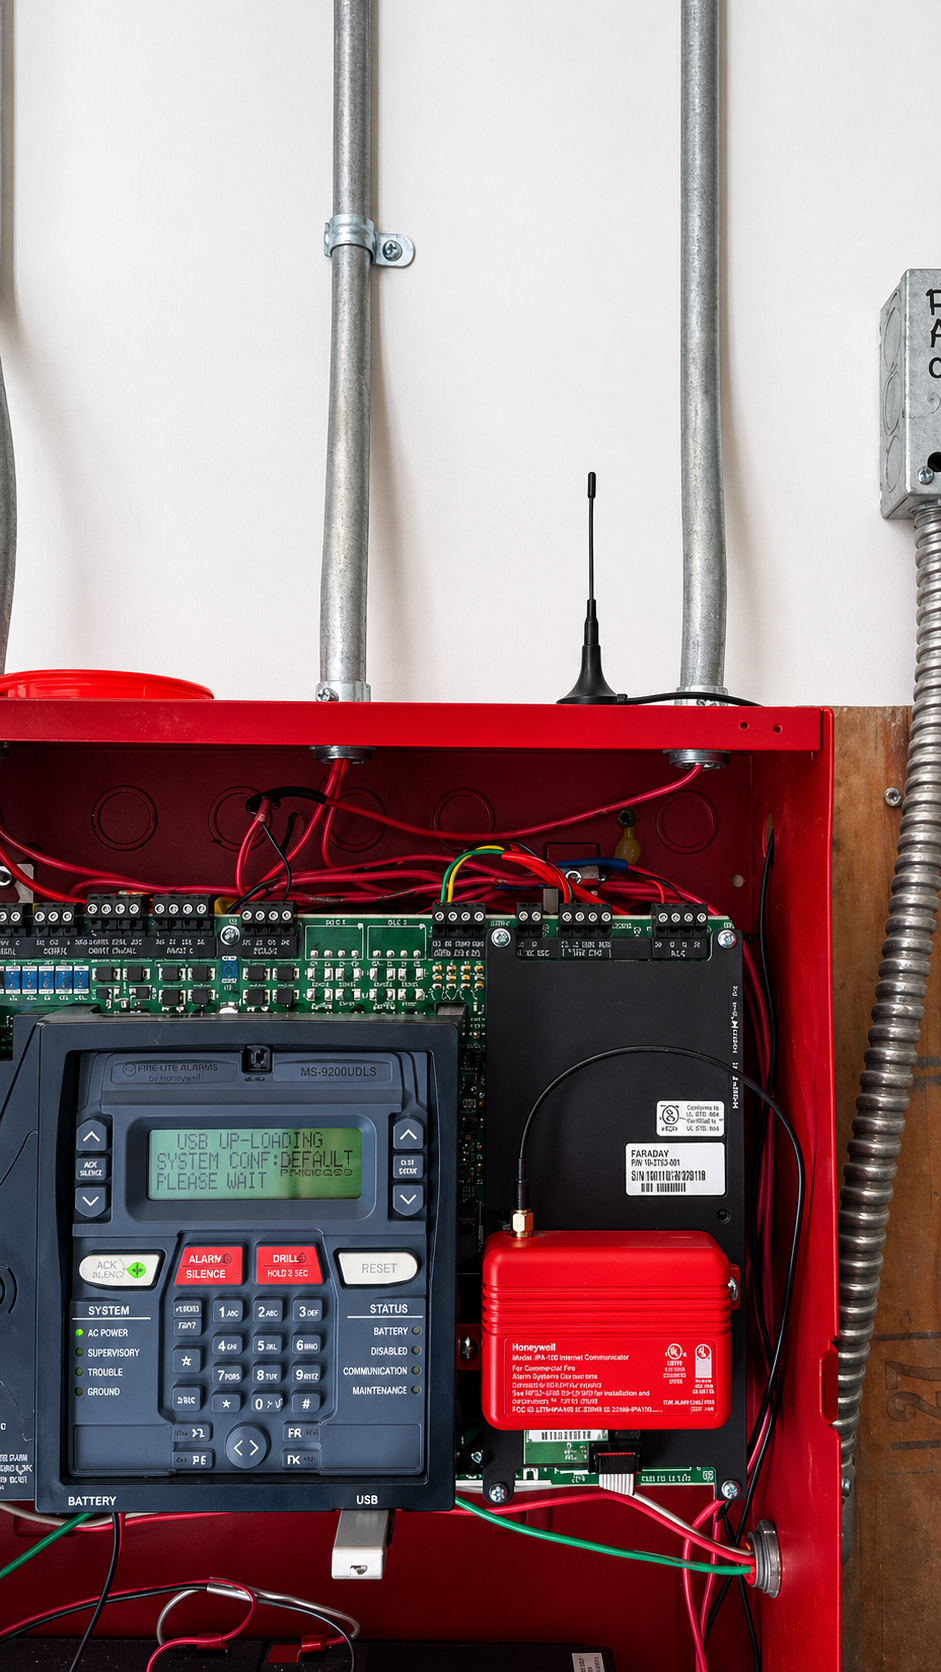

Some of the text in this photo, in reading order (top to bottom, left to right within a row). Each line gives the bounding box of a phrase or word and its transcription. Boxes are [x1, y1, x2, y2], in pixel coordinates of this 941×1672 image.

[180, 1063, 218, 1071] ALARMS
[300, 1066, 377, 1077] MS-9200UDLS
[177, 1131, 323, 1150] USB UP-LOADING
[631, 1149, 669, 1158] FARADAY
[157, 1149, 353, 1170] SYSTEM CONF:DEFAULT
[157, 1172, 218, 1190] PLEASE
[226, 1171, 267, 1190] WAIT
[272, 1254, 300, 1263] DRILL
[95, 1260, 118, 1270] ACK
[361, 1263, 398, 1274] RESET
[186, 1269, 226, 1279] SILENCE
[267, 1269, 308, 1277] HOLD 2 SEC
[88, 1305, 130, 1315] SYSTEM
[257, 1306, 265, 1318] 2
[299, 1306, 306, 1318] 3
[369, 1304, 409, 1314] STATUS
[87, 1328, 129, 1337] AC POWER
[373, 1326, 409, 1336] BATTERY
[217, 1340, 226, 1352] 4
[257, 1340, 265, 1351] 5
[296, 1340, 304, 1351] 6
[512, 1342, 556, 1353] Honeywell
[87, 1348, 140, 1358] SUPERVISORY
[370, 1346, 408, 1356] DISABLED
[87, 1368, 124, 1377] TROUBLE
[217, 1369, 225, 1382] 7
[256, 1369, 265, 1381] 8
[295, 1369, 303, 1381] 9
[342, 1366, 408, 1376] COMMUNICATION
[87, 1387, 121, 1396] GROUND
[352, 1386, 408, 1395] MAINTENANCE
[67, 1496, 117, 1506] BATTERY
[356, 1494, 379, 1505] USB
